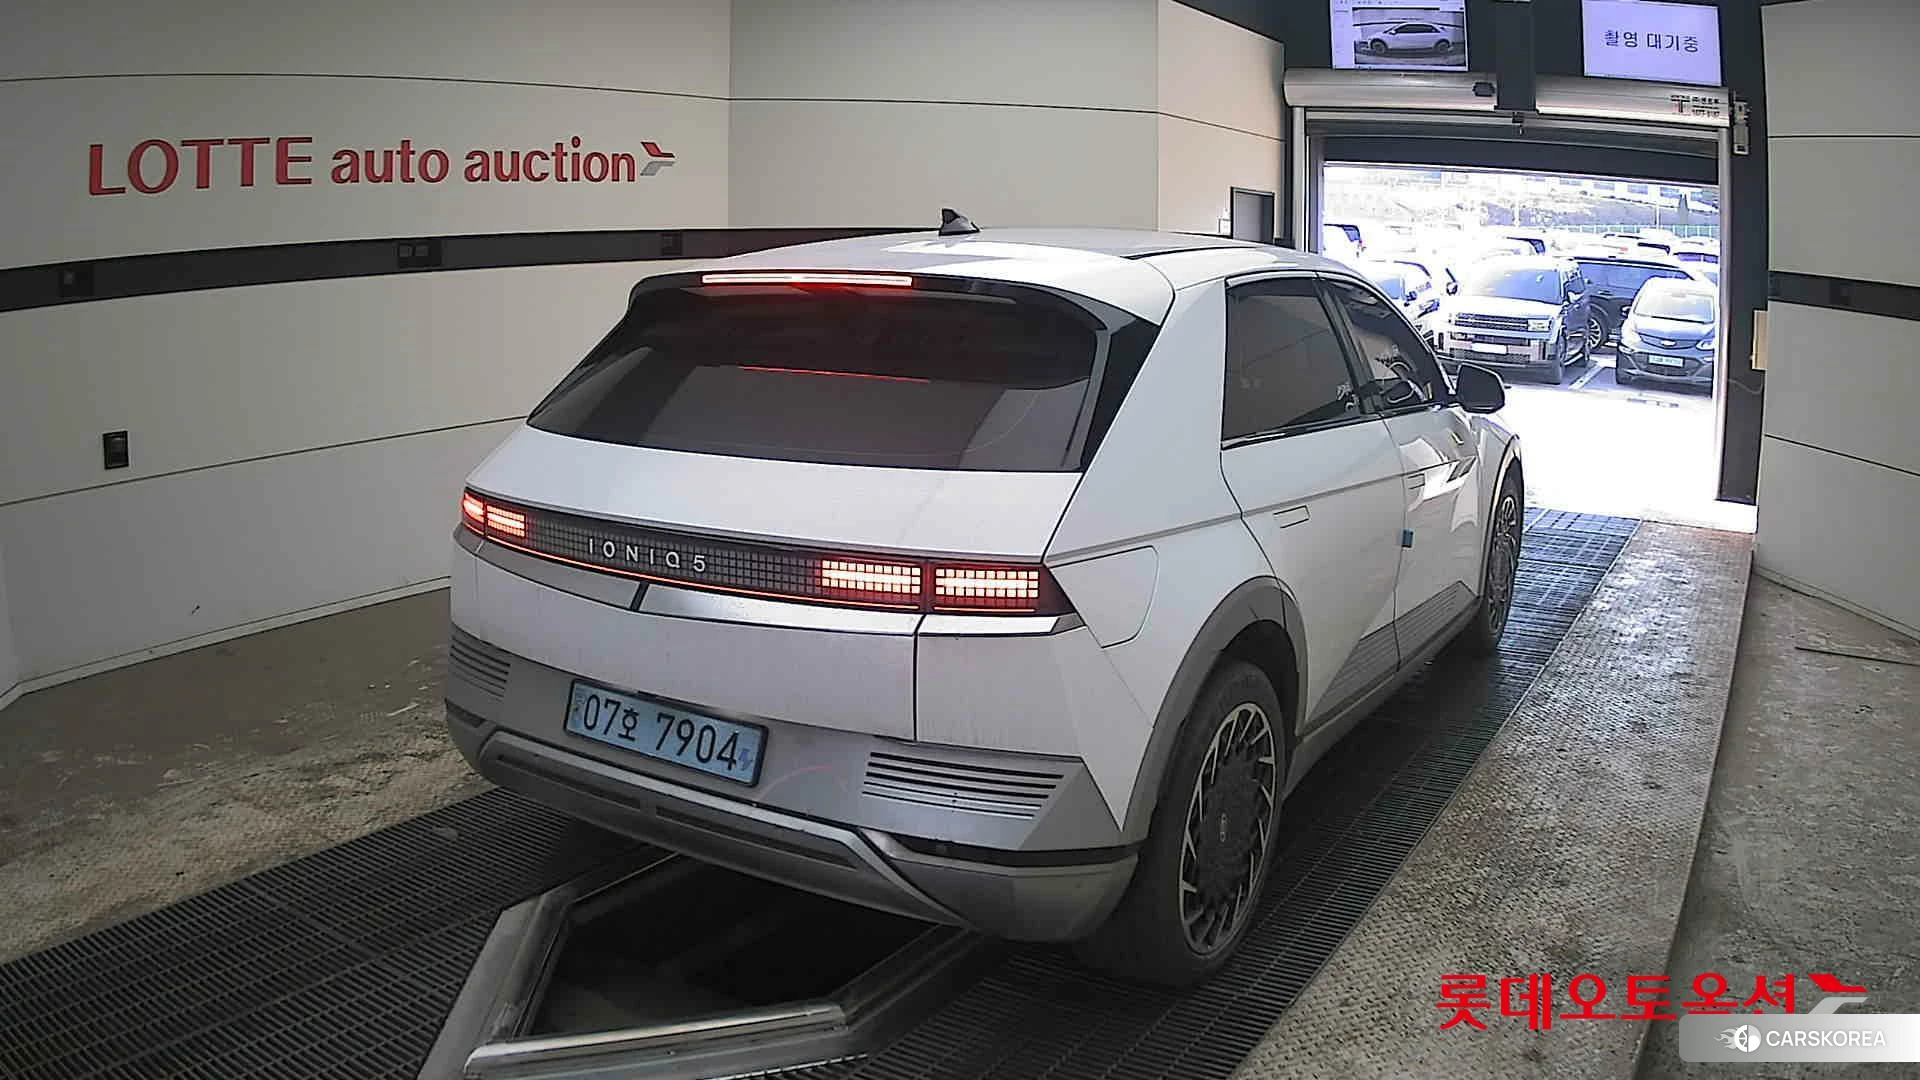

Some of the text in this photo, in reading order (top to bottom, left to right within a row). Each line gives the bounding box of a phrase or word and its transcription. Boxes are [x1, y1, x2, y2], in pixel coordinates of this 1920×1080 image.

[1603, 29, 1699, 53] 촬영 대기중
[89, 136, 637, 195] LOTTE auto auction
[588, 538, 706, 572] IONIQ 5
[583, 694, 740, 771] 07호 7904
